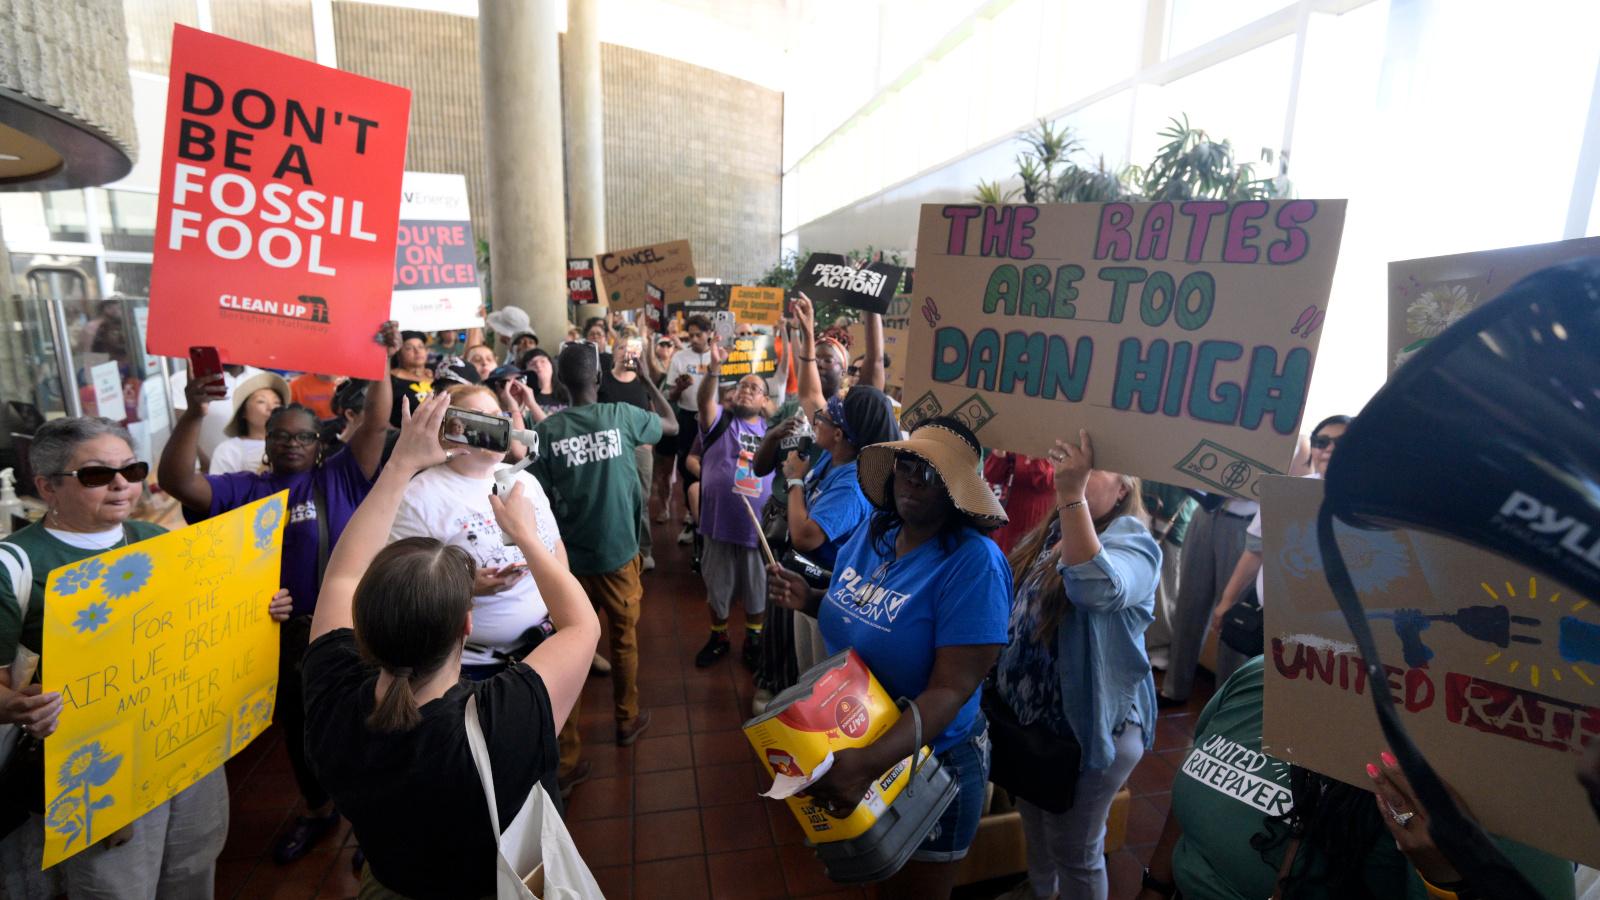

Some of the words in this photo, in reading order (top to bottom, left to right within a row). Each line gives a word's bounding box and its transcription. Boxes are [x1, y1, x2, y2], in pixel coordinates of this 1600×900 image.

[182, 72, 379, 155] DON'T
[178, 118, 254, 172] BE
[272, 144, 313, 186] A
[172, 163, 377, 242] FOSSIL
[168, 208, 336, 277] FOOL
[397, 225, 466, 246] OU'RE
[405, 245, 445, 265] ON
[601, 248, 665, 274] CANCEL
[942, 204, 1040, 260] THE
[1094, 199, 1318, 265] RATES
[811, 263, 882, 284] PEOPLE'S
[982, 263, 1086, 321] ARE
[1097, 266, 1217, 331] TOO
[219, 294, 279, 314] CLEAN
[282, 303, 307, 318] UP
[931, 326, 1094, 403] DAMN
[1111, 335, 1312, 435] HIGH
[551, 430, 618, 457] PEOPLE'S
[131, 602, 173, 646] FOR
[184, 590, 221, 618] THE
[62, 667, 121, 709] AIR
[132, 643, 170, 685] WE
[184, 589, 266, 663] BREATHE
[116, 686, 151, 715] AND
[162, 667, 191, 692] THE
[142, 669, 220, 732] WATER
[231, 647, 256, 683] WE
[154, 702, 227, 760] DRINK
[1201, 734, 1267, 773] UNITED
[881, 764, 905, 790] PURINA
[1185, 752, 1294, 816] RATEPAYER
